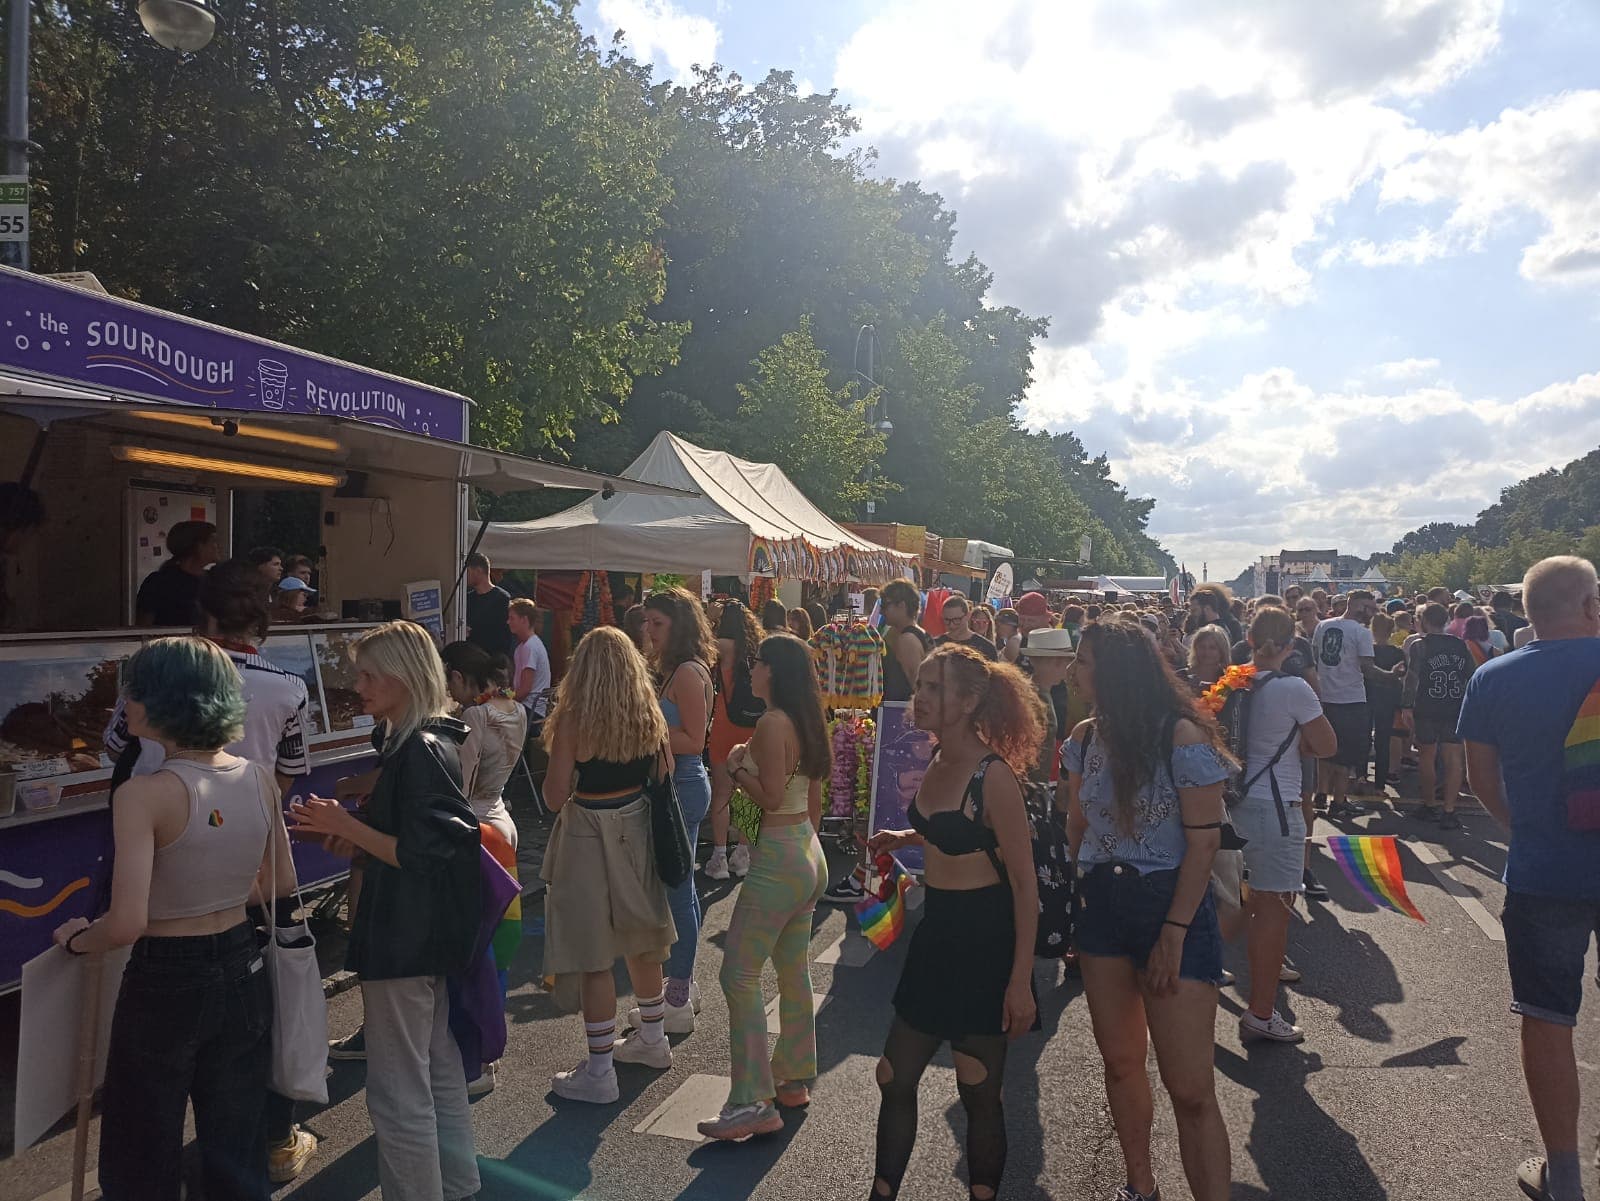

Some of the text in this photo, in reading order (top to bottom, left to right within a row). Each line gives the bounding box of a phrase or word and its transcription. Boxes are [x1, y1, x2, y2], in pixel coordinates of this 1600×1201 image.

[8, 187, 25, 196] 757
[0, 215, 24, 234] 55
[39, 312, 406, 420] the SOURDOUGH REVOLUTION
[1428, 670, 1462, 699] 33
